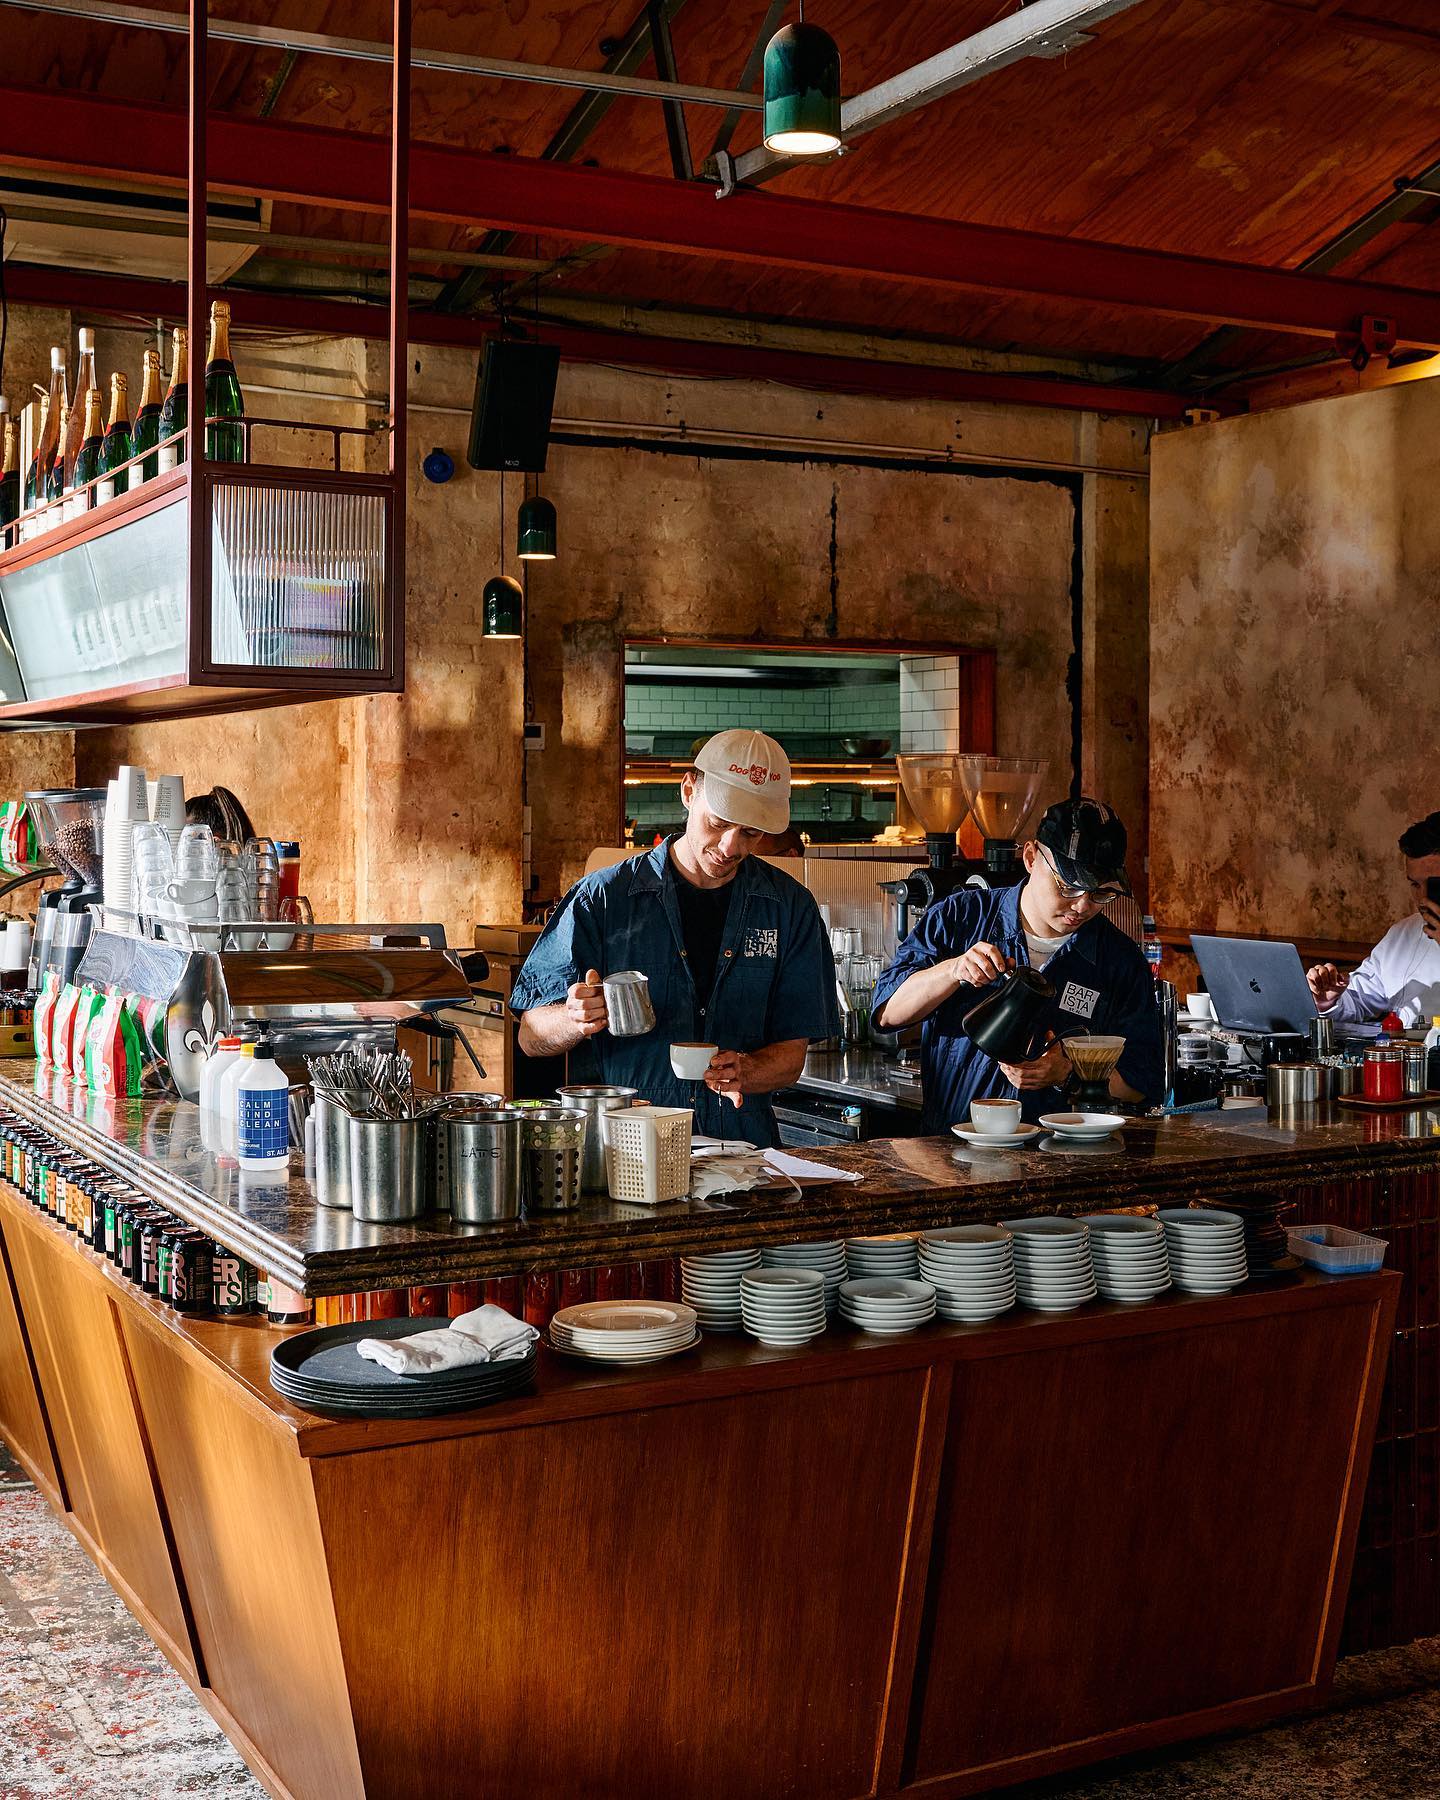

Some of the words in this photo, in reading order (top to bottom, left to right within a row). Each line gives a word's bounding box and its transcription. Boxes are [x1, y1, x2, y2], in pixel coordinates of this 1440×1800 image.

[1063, 994, 1089, 1012] ISTA
[239, 1101, 271, 1109] CALM
[239, 1110, 271, 1118] KIND
[239, 1120, 280, 1128] CLEAN
